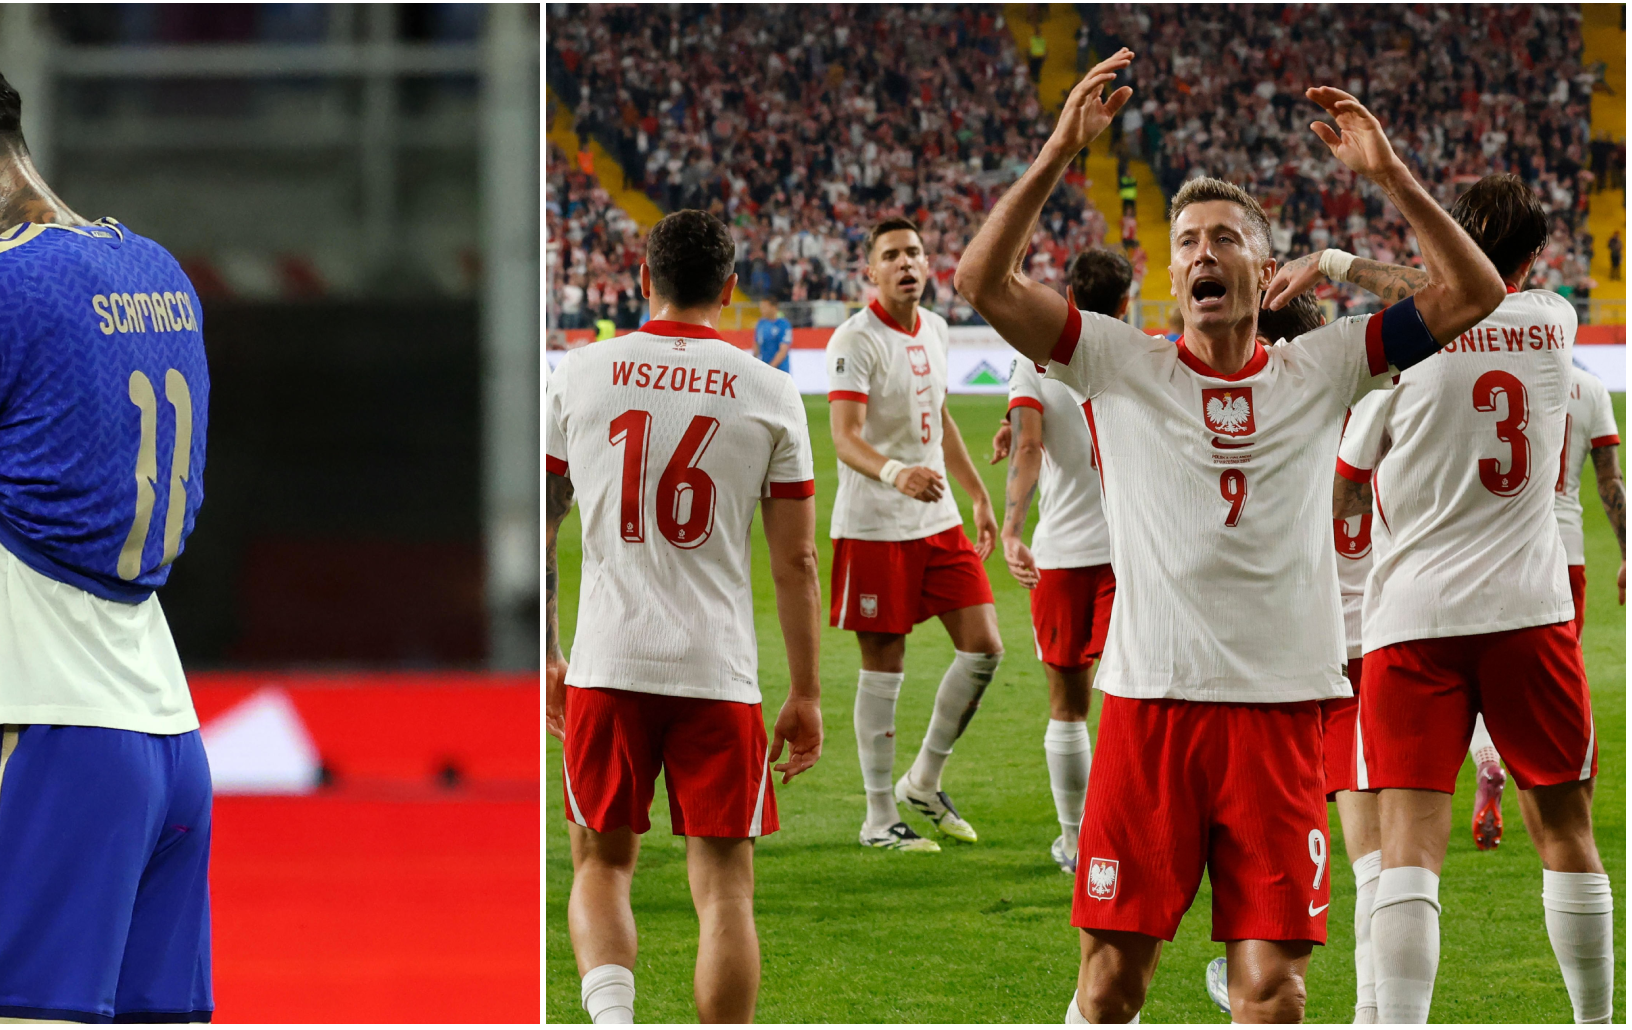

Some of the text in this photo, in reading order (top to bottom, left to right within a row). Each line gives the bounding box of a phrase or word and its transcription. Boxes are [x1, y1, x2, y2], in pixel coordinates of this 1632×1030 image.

[612, 360, 738, 398] WSZOŁEK
[921, 412, 931, 445] 5
[1472, 370, 1532, 498] 3
[117, 368, 193, 581] 11
[608, 409, 720, 549] 16
[1219, 468, 1248, 528] 9
[1308, 828, 1327, 890] 9
